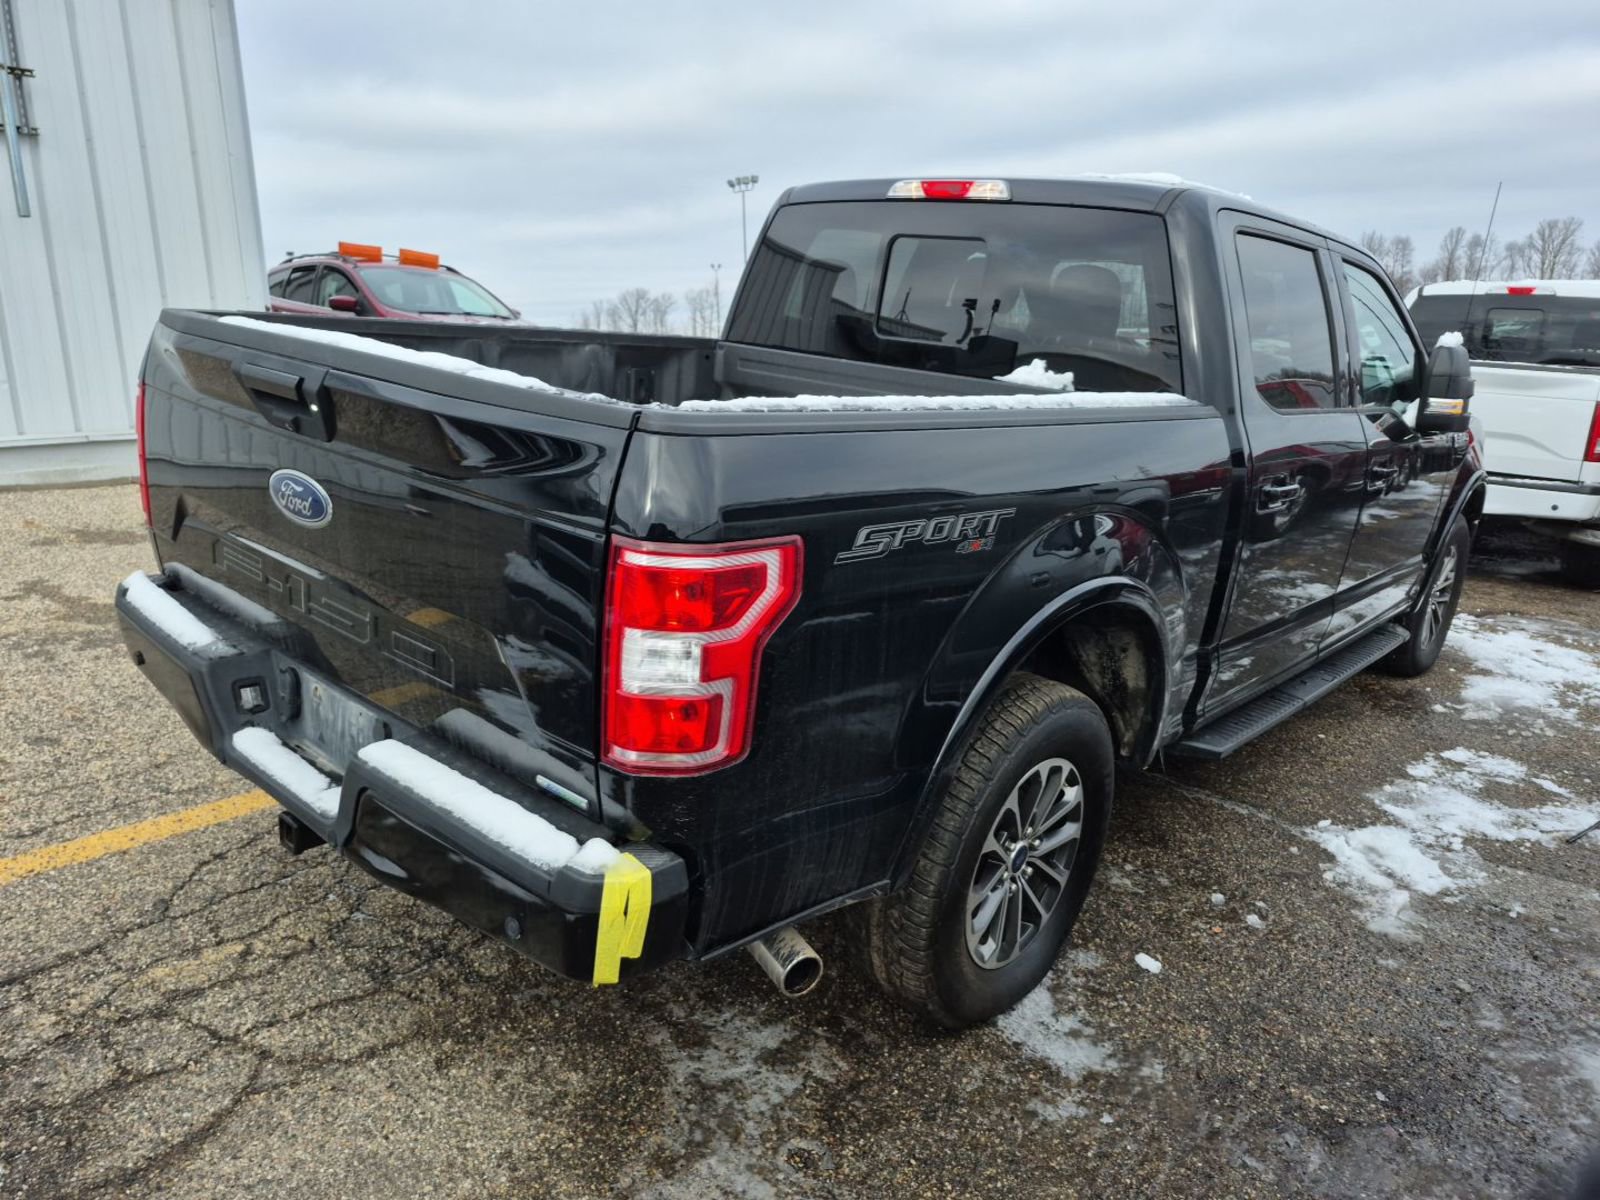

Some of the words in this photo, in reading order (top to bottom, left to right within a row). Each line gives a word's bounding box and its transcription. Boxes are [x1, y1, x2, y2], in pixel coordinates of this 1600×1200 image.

[278, 479, 314, 516] Ford
[833, 507, 1017, 565] SPORT
[212, 537, 456, 690] F-150
